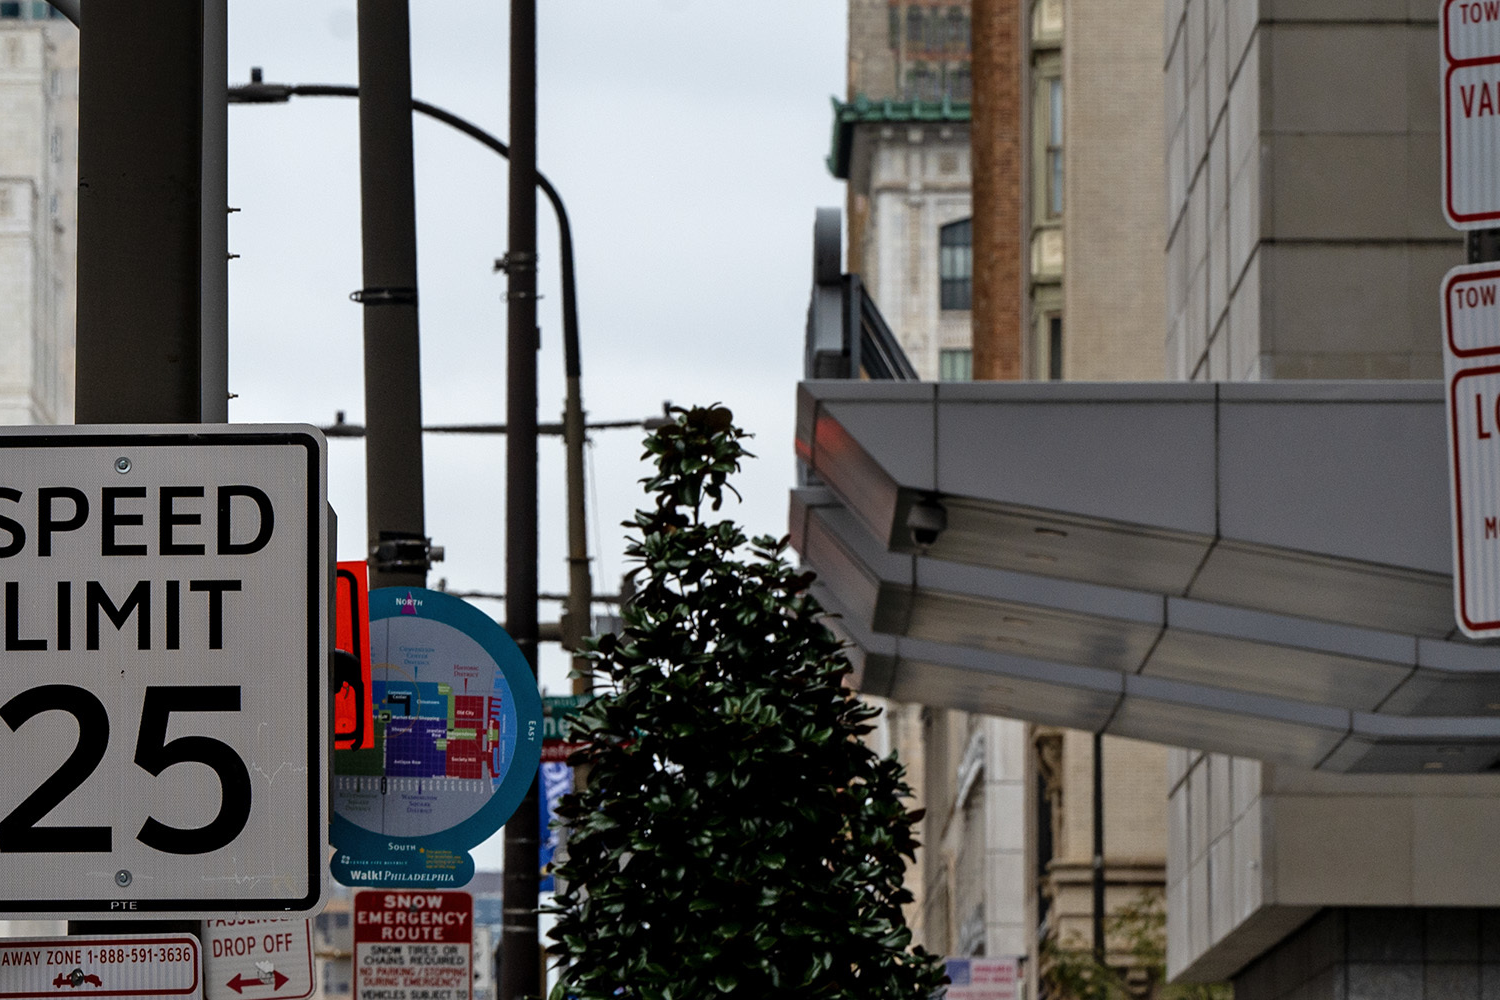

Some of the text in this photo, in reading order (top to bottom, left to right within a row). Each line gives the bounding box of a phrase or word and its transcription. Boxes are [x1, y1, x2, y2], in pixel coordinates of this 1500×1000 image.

[1459, 0, 1500, 24] TOW
[1460, 81, 1500, 118] VA
[1455, 284, 1496, 309] TOW
[5, 579, 242, 652] LIMIT
[528, 720, 536, 742] EAST
[350, 870, 455, 882] Walk! PHILADELPHIA
[110, 901, 138, 910] PTE
[383, 894, 443, 909] SNOW
[357, 911, 468, 926] EMERGENCY
[381, 926, 444, 941] ROUTE
[212, 933, 293, 958] DROP OFF
[371, 945, 402, 955] SNOW
[407, 945, 438, 955] TIRES
[1, 951, 41, 966] AWAY
[46, 950, 82, 965] ZONE
[87, 947, 191, 964] 1-888-591-3636
[364, 955, 465, 966] CHAINS REQUIRED
[359, 967, 373, 976] NO
